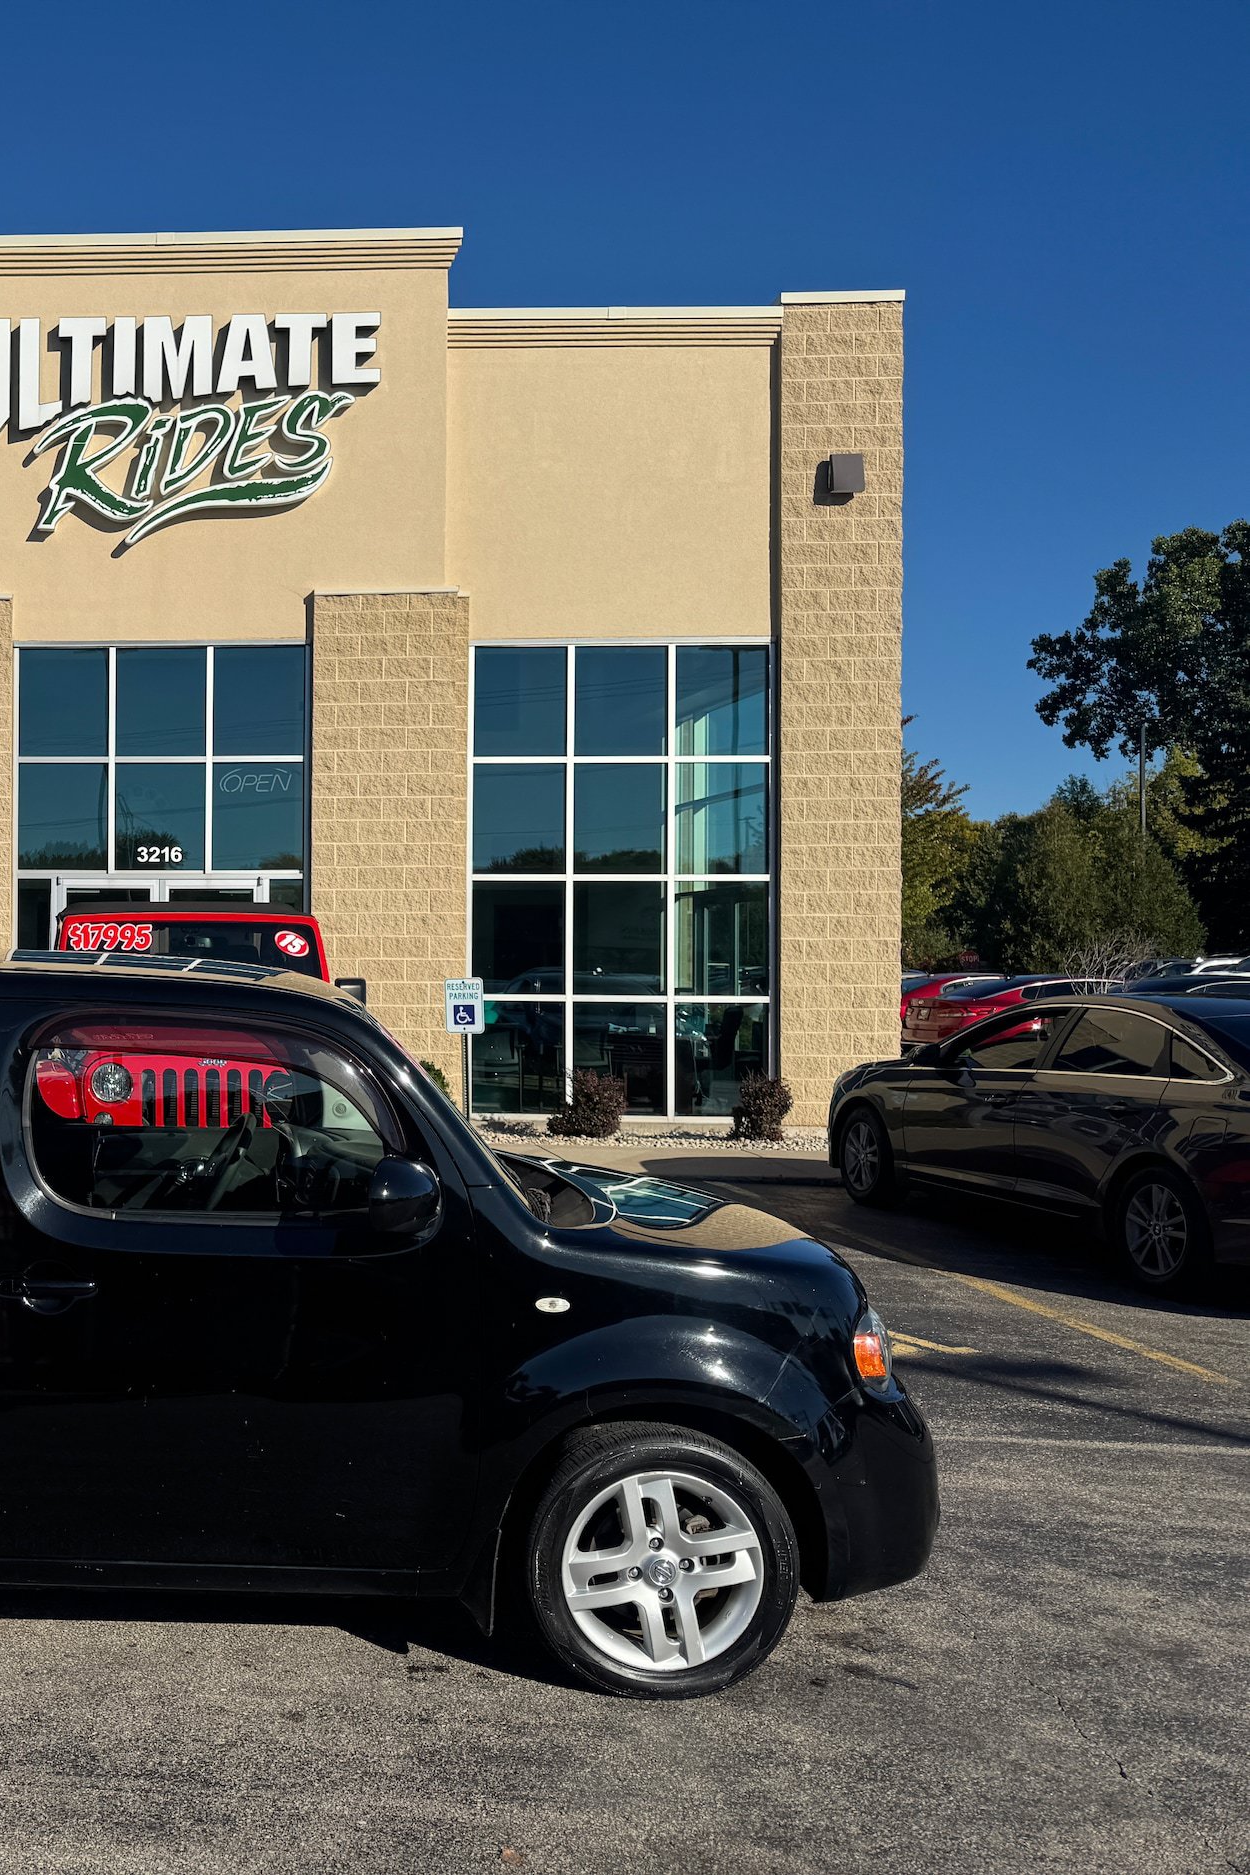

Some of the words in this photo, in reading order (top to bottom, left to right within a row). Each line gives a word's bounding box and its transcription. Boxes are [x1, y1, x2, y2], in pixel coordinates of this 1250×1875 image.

[223, 774, 292, 792] OPEN
[136, 846, 183, 863] 3216
[68, 923, 153, 951] $17995
[279, 934, 306, 953] 15
